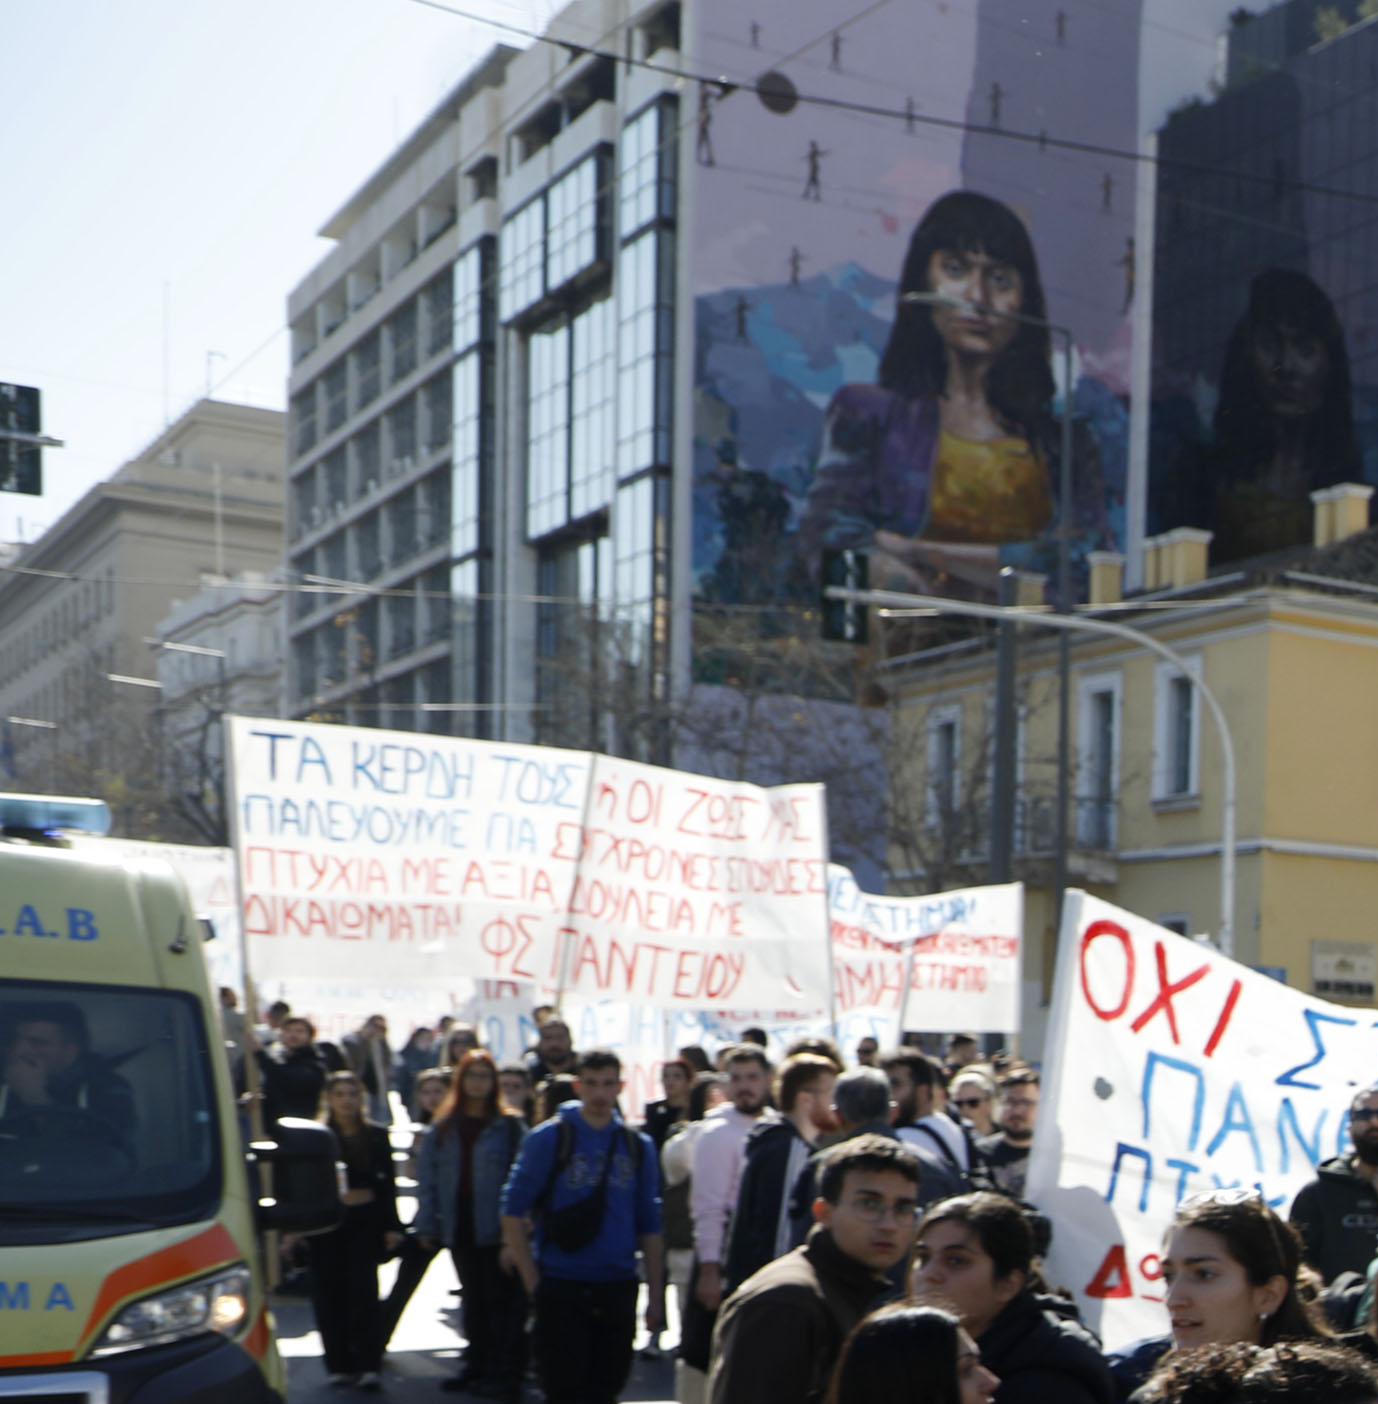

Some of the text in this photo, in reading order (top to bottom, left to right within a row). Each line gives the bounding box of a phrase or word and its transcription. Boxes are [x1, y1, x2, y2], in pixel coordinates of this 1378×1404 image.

[250, 731, 333, 786] ΤΑ
[352, 740, 475, 800] ΚΕΡΔΗ
[491, 754, 585, 809] ΤΟΥΣ
[245, 794, 465, 850] ΠΑΛΕΥΟΥΜΕ
[0, 903, 99, 941] .Α.Β
[245, 846, 389, 896] ΠΤΥΧΙΑ
[402, 857, 450, 897] ΜΕ
[706, 902, 745, 936] ΜΕ
[245, 893, 463, 941] ΔΙΚΑΙΩΜΑΤΑ!
[549, 926, 745, 999] ΠΑΝΤΕΙΟΥ
[1079, 919, 1244, 1058] ΟΧΙ
[0, 1281, 76, 1311] ΜΑ
